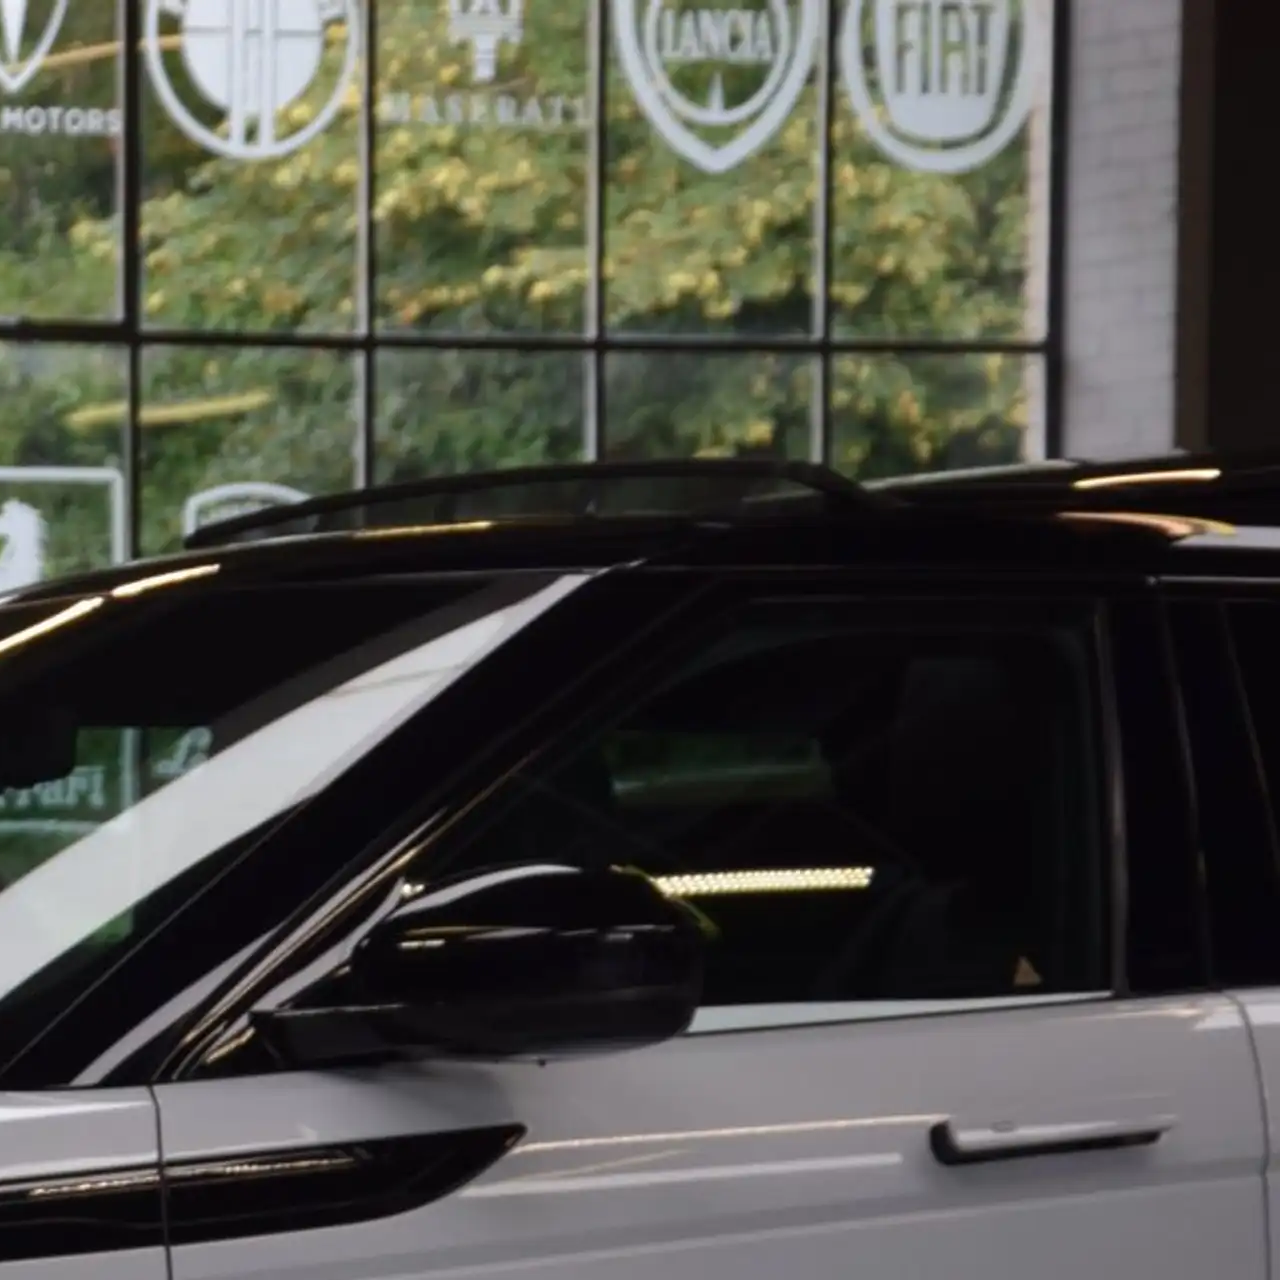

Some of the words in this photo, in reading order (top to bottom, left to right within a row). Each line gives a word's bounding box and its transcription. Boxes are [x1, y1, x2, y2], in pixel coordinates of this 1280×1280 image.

[662, 7, 774, 63] LANCIA
[895, 3, 996, 95] FIAT
[0, 105, 124, 135] MOTORS
